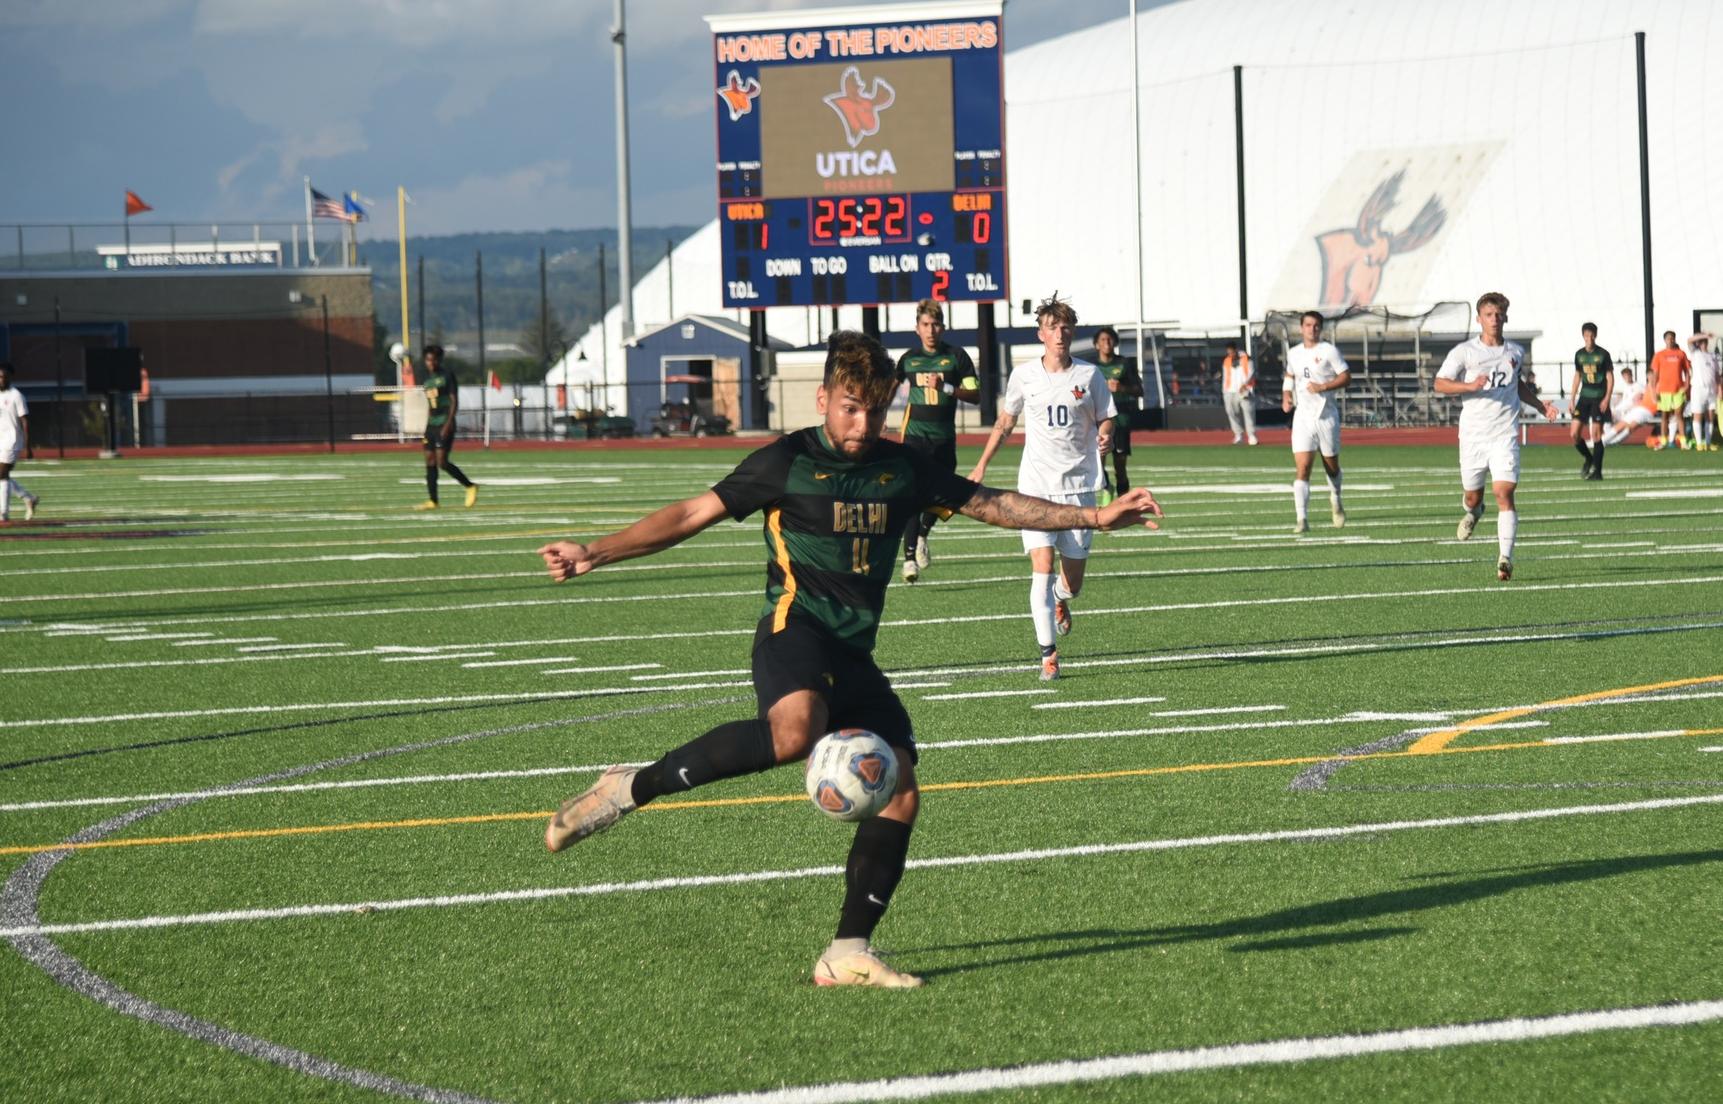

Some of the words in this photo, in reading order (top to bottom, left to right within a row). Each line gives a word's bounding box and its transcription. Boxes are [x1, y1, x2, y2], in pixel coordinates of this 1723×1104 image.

[716, 34, 787, 63] HOME
[788, 31, 822, 58] OF
[825, 28, 874, 57] THE
[875, 21, 998, 54] PIONEERS
[816, 149, 897, 177] UTICA
[815, 197, 905, 238] 25:22
[973, 212, 990, 244] 0
[761, 223, 768, 250] 1
[765, 258, 801, 277] DOWN
[810, 257, 828, 275] TO
[828, 256, 847, 275] GO
[869, 255, 900, 273] BALL
[900, 254, 919, 272] ON
[931, 271, 949, 302] 2
[1491, 371, 1507, 388] 12
[924, 386, 939, 405] 10
[1047, 404, 1068, 427] 10
[833, 501, 888, 534] DELHI
[852, 537, 870, 575] 11
